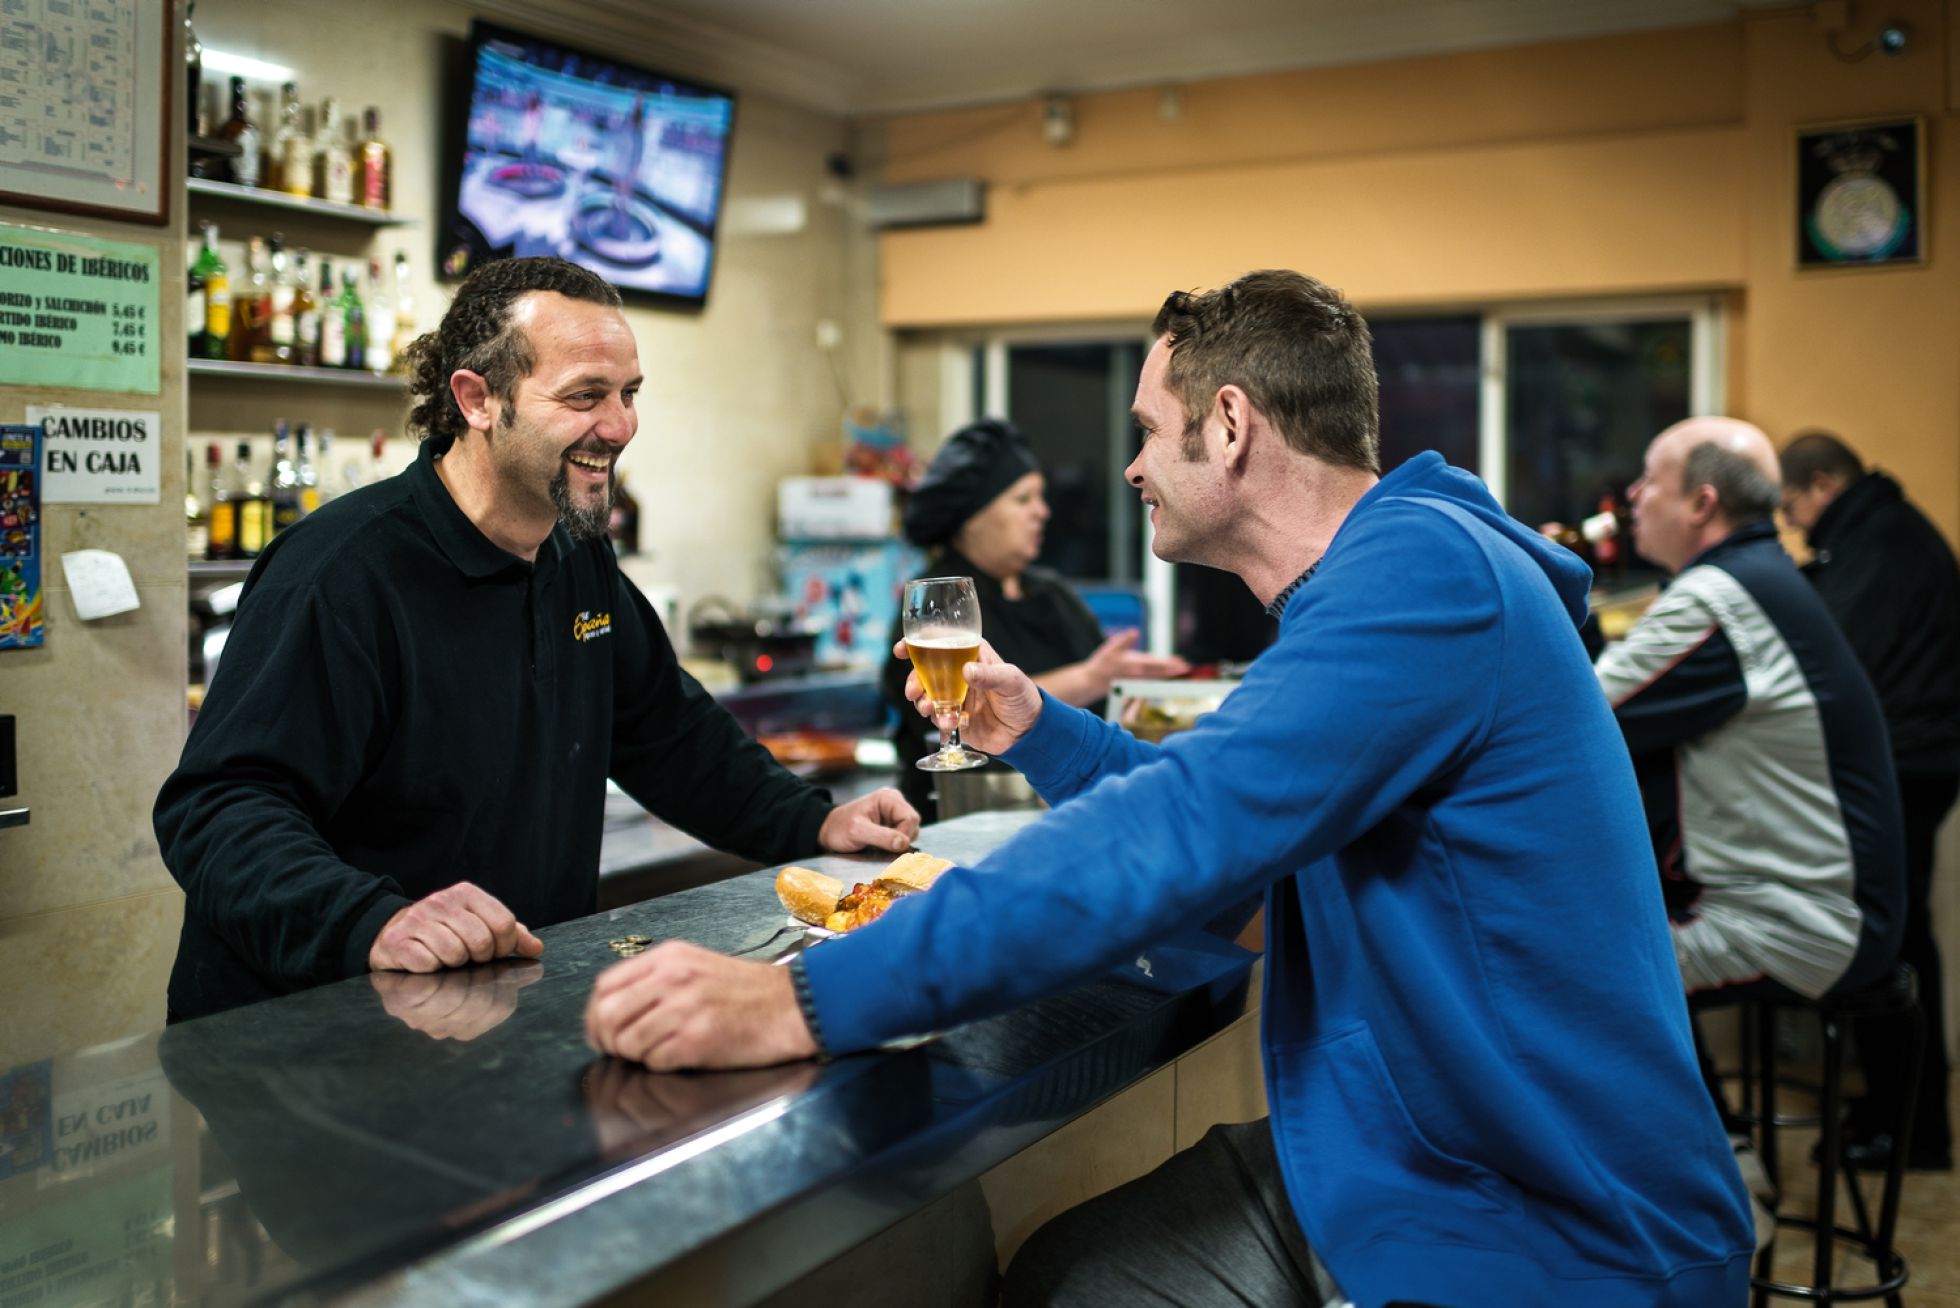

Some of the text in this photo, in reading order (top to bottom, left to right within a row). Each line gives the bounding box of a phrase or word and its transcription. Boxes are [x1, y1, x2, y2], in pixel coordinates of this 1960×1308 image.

[56, 252, 77, 274] DE
[81, 255, 149, 284] IBÉRICOS
[34, 313, 77, 331] IBÉRICO
[18, 330, 62, 348] IBÉRICO
[42, 416, 147, 443] CAMBIOS
[47, 450, 141, 475] EN CAJA
